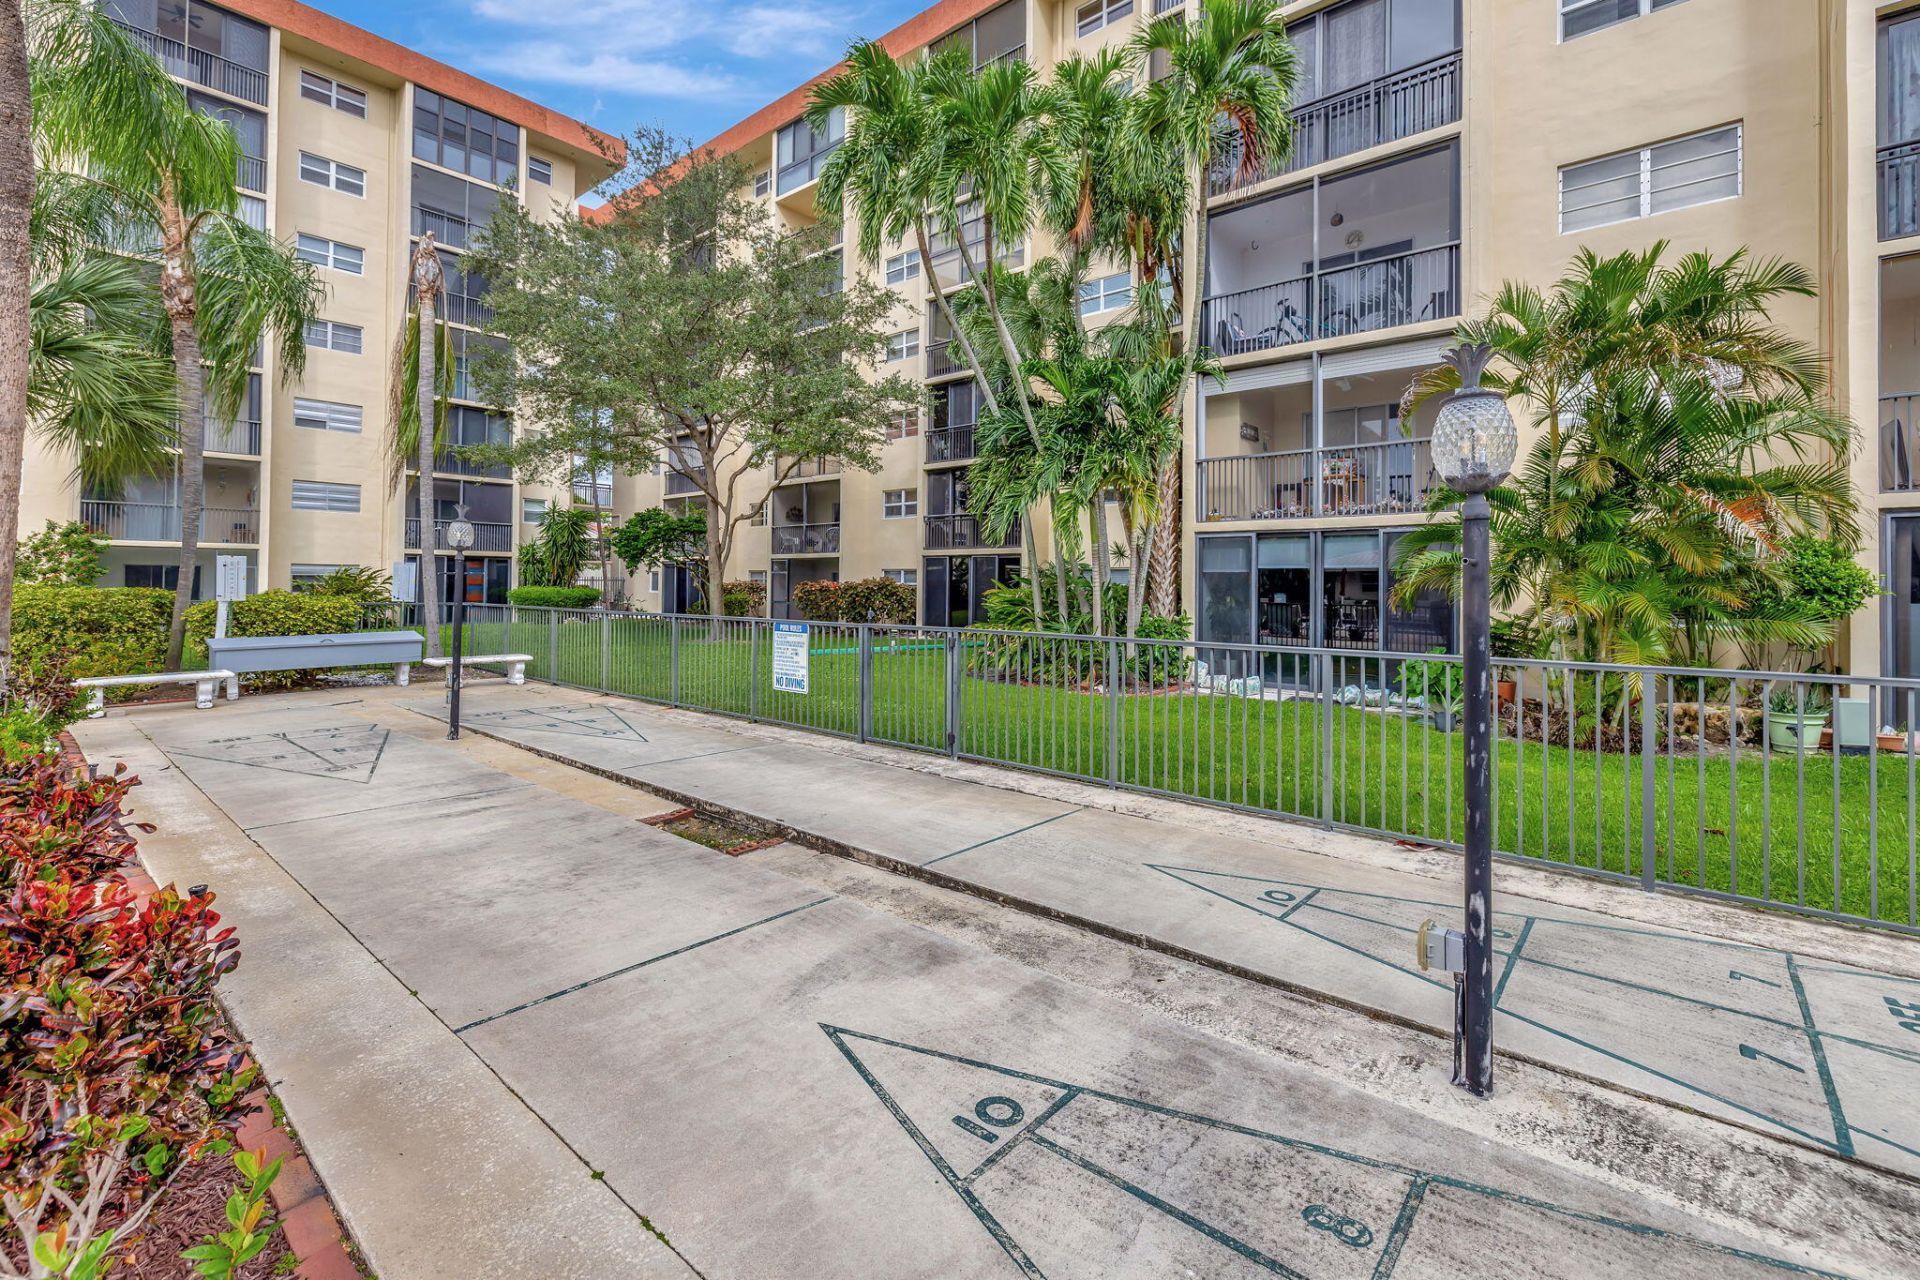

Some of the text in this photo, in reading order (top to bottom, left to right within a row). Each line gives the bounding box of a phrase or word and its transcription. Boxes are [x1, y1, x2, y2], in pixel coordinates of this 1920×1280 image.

[776, 675, 784, 687] NO
[785, 677, 805, 690] DIVING
[1257, 889, 1296, 908] 10
[1739, 1043, 1806, 1074] 7
[952, 1095, 1025, 1143] 10
[1302, 1204, 1374, 1248] 8
